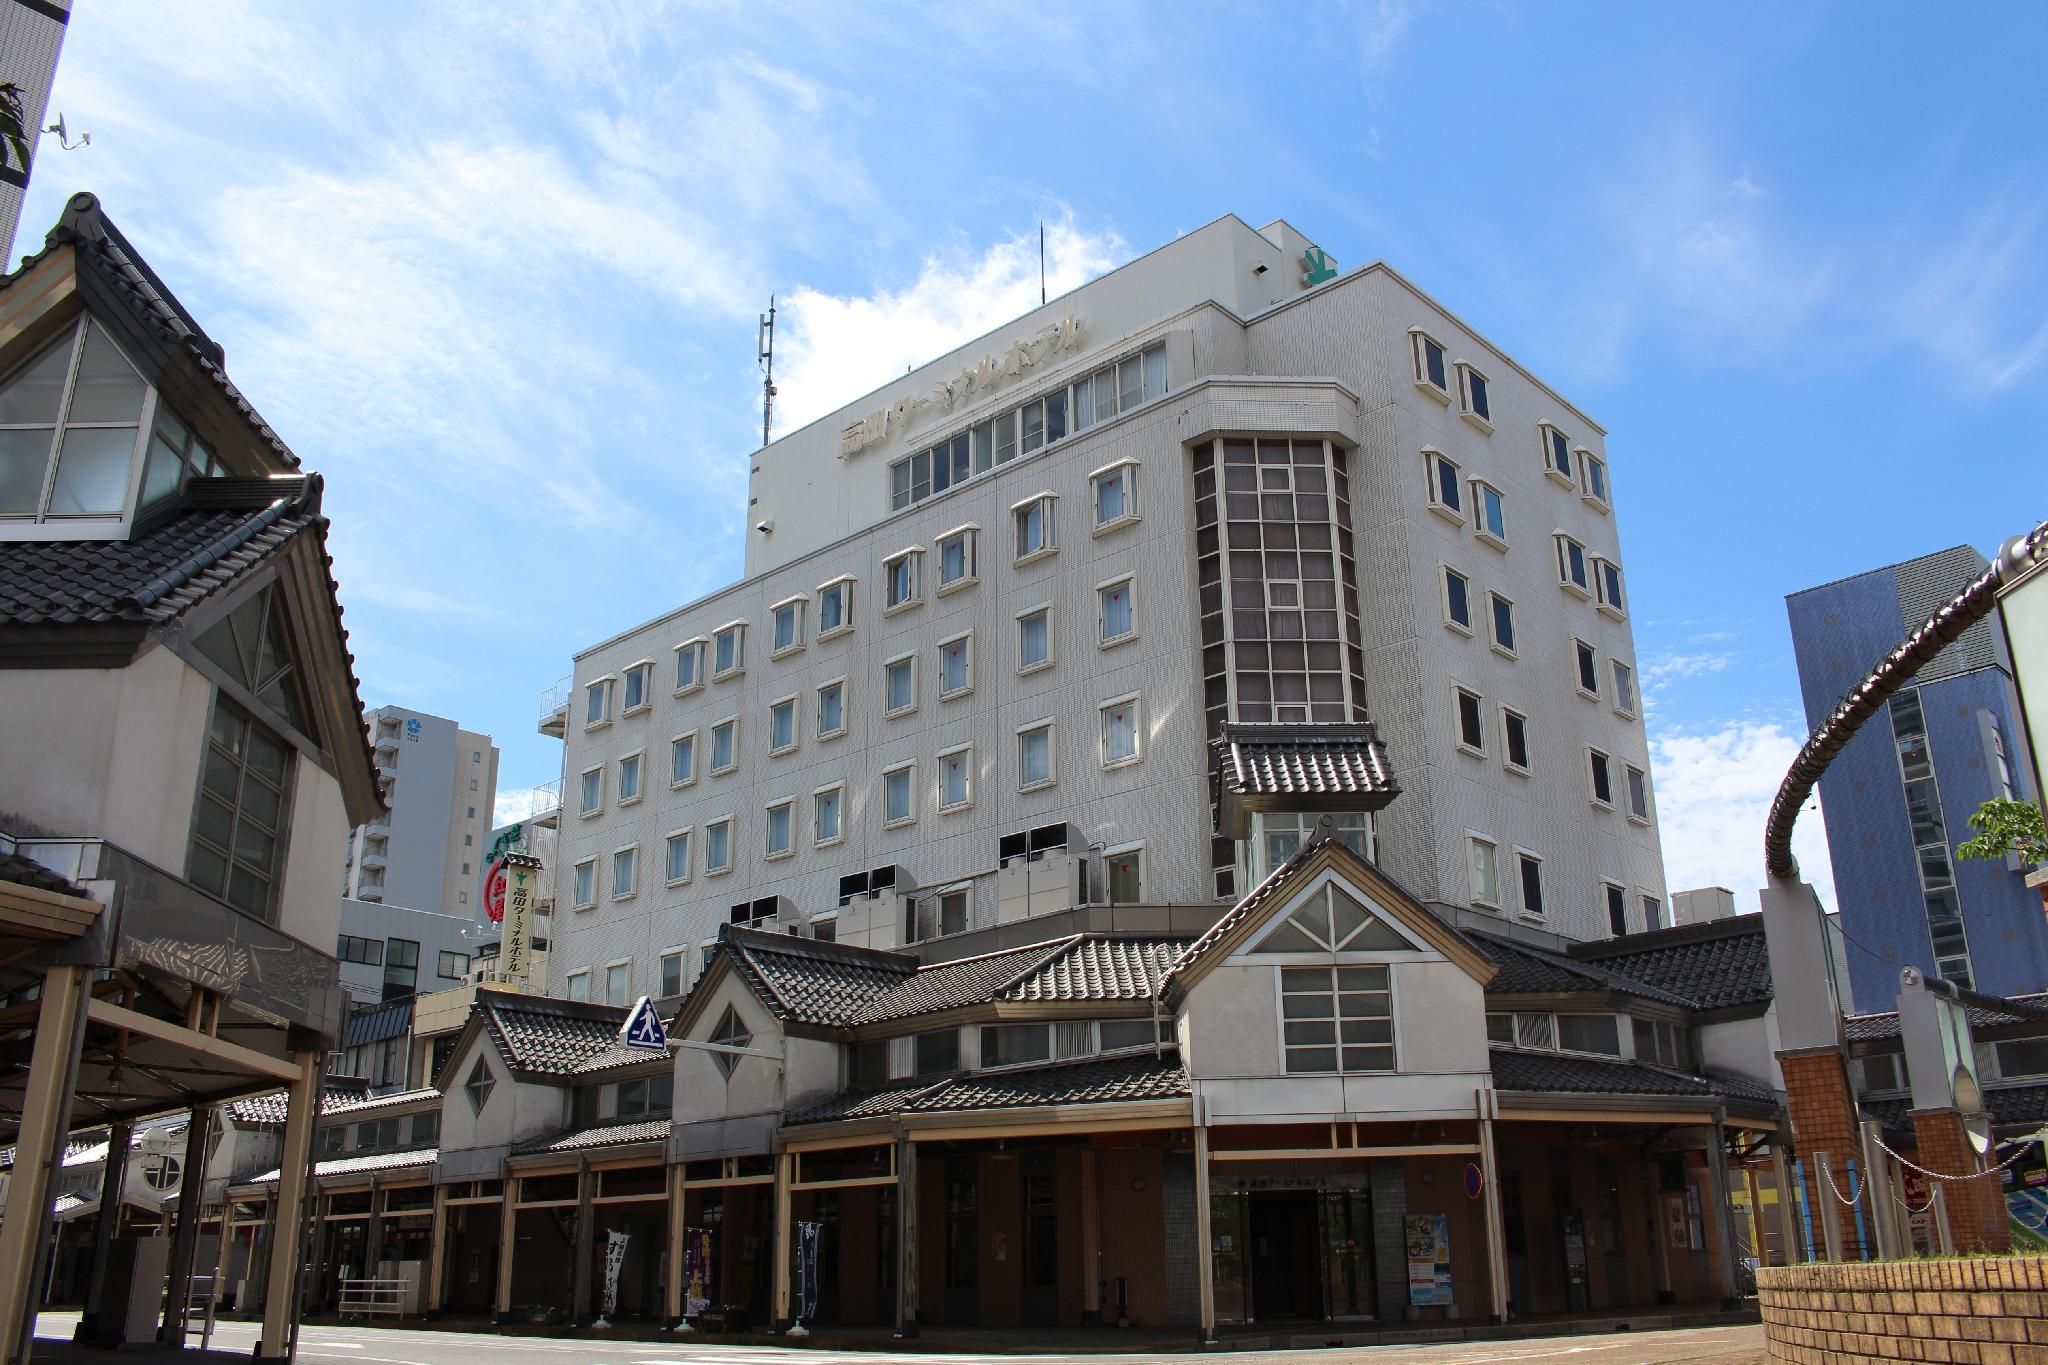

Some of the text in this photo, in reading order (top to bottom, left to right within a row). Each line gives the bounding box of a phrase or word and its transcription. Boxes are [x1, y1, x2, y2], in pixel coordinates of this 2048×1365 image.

[508, 887, 528, 972] 高田ターミナルホテル
